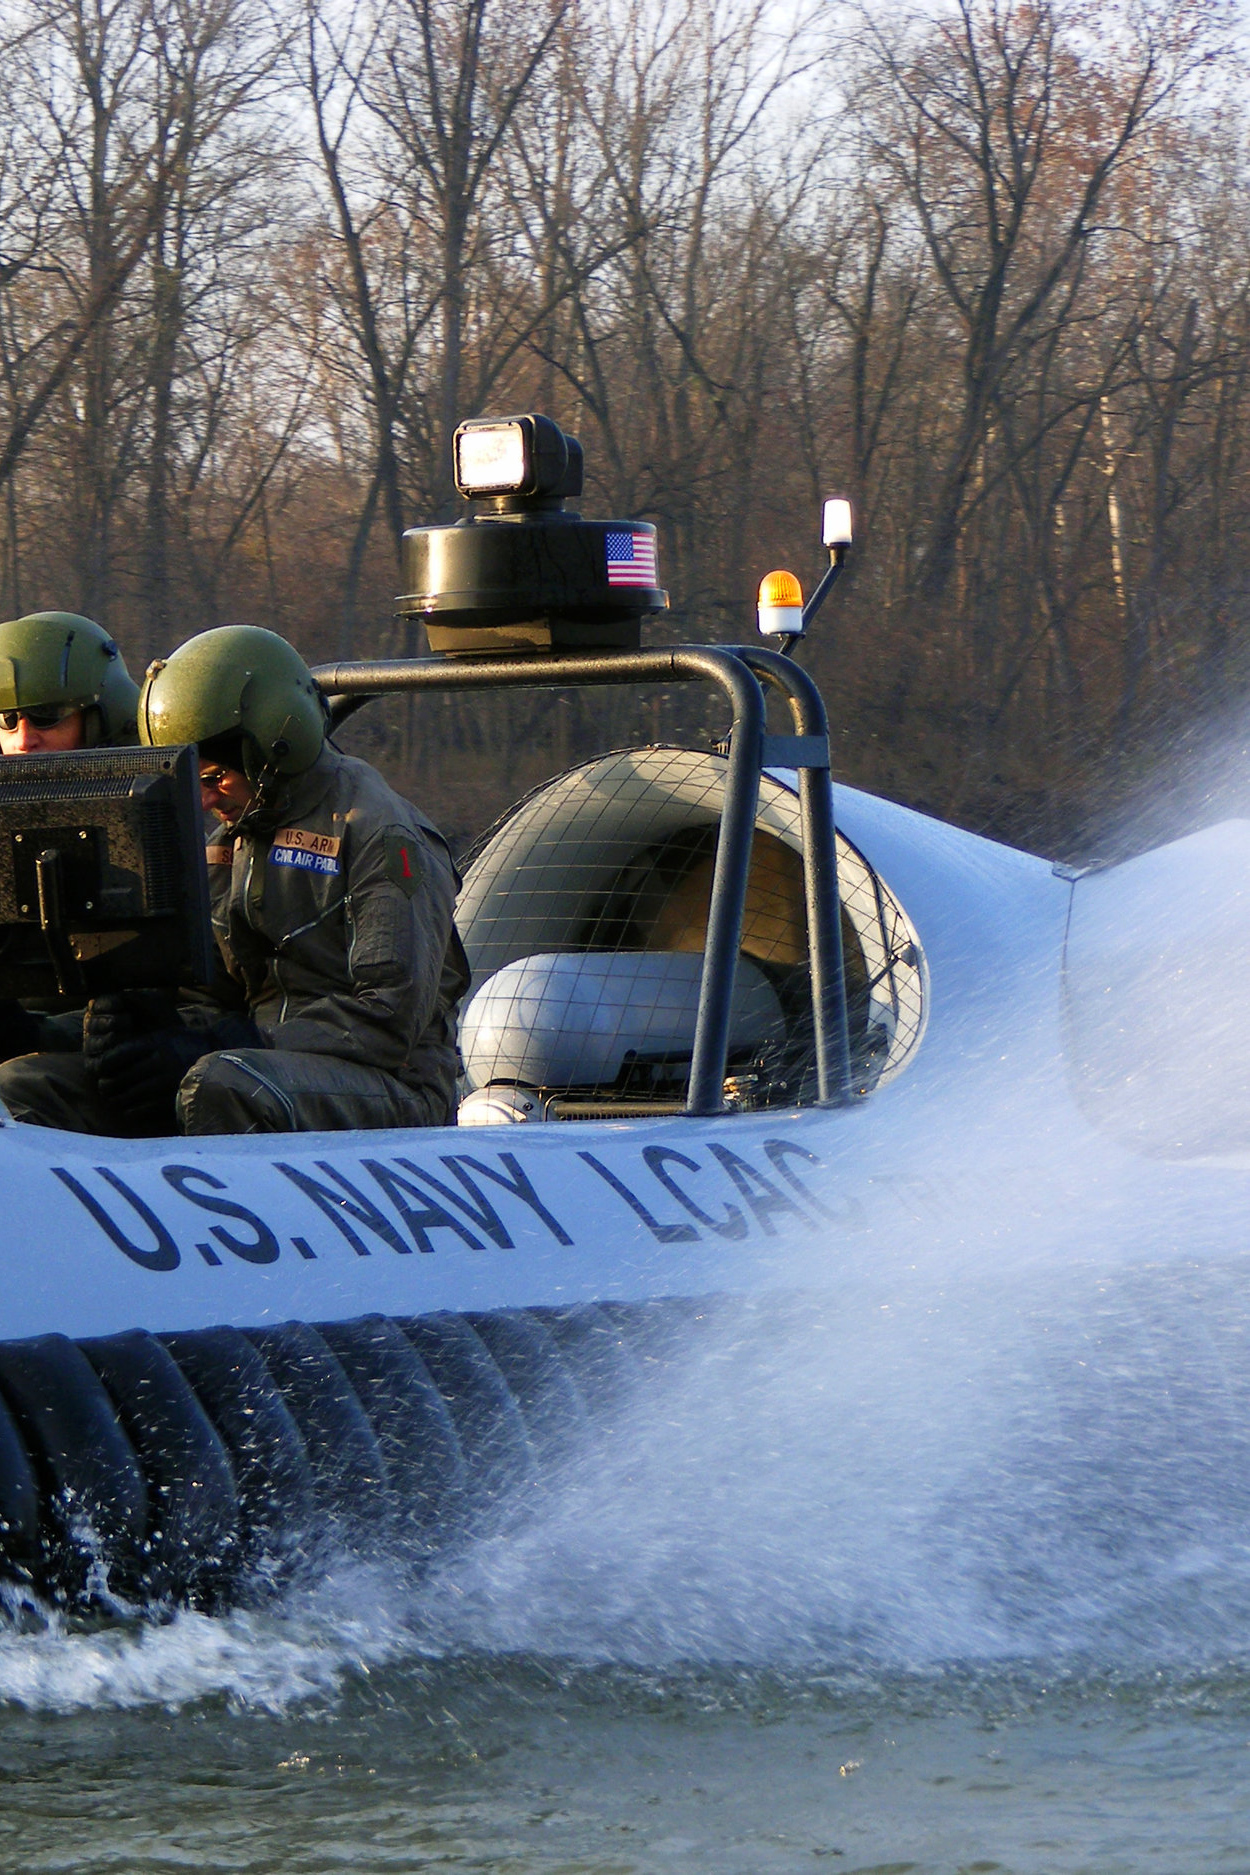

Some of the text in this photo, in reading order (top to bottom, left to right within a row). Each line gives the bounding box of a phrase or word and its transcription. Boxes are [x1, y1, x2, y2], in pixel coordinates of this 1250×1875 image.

[286, 831, 305, 846] U.S.
[294, 851, 311, 867] AIR
[49, 1164, 318, 1272] U.S.
[271, 1151, 575, 1256] NAVY
[575, 1138, 862, 1244] LCAC
